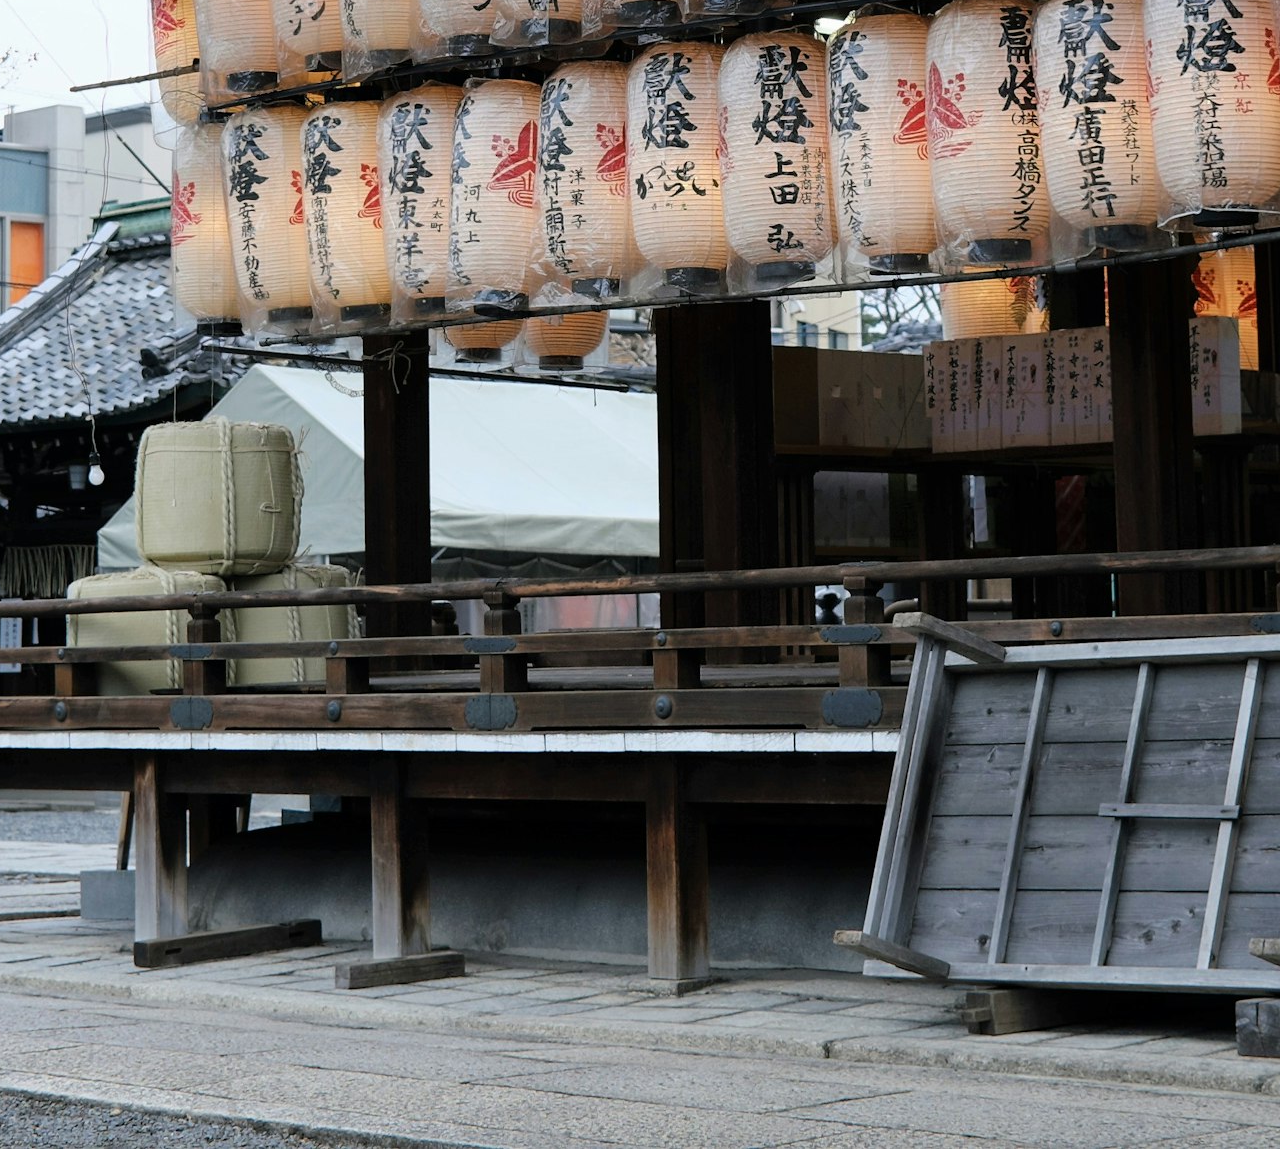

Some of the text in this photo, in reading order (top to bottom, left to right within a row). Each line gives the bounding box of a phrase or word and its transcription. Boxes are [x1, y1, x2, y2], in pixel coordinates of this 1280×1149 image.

[1233, 72, 1254, 114] 京紅
[1068, 107, 1118, 218] 廣田正行
[430, 197, 445, 233] 丸太町
[463, 183, 481, 244] 河丸上
[543, 172, 579, 275] 村上開新堂
[569, 167, 586, 229] 洋菓子
